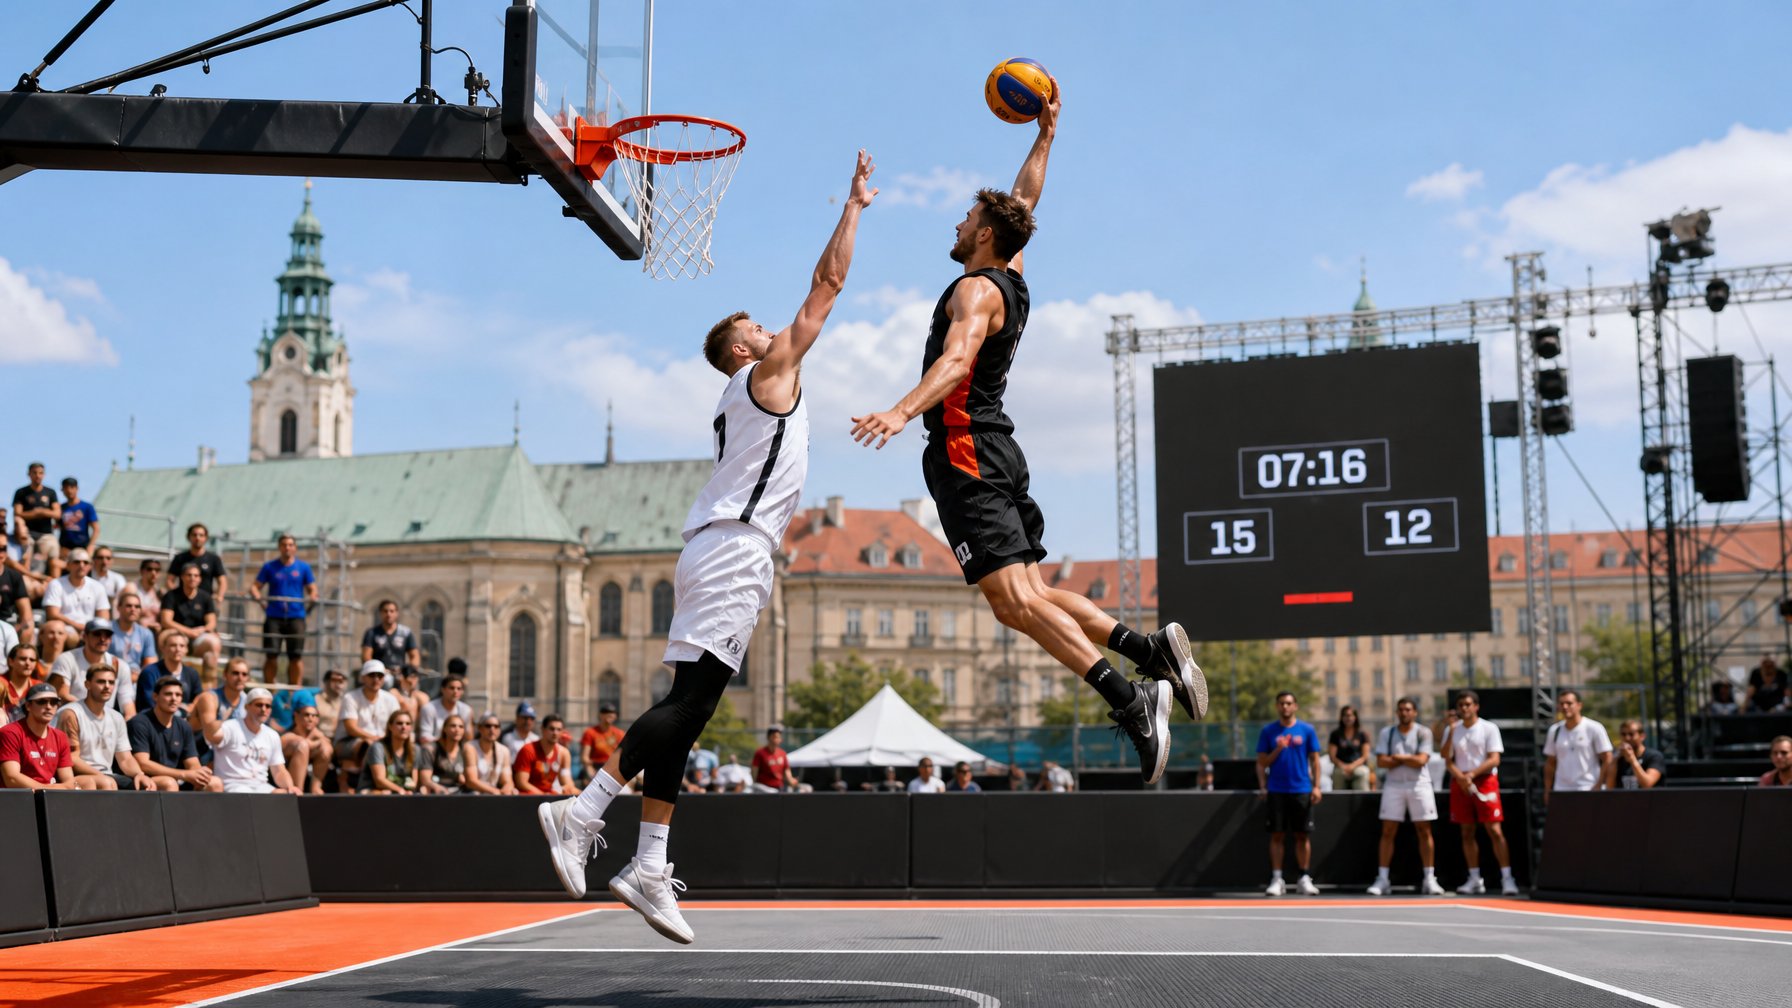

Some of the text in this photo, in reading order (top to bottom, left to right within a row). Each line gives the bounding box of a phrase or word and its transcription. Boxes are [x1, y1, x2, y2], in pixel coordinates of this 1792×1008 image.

[1257, 448, 1367, 489] 07:16
[1210, 519, 1256, 556] 15
[1384, 508, 1432, 546] 12
